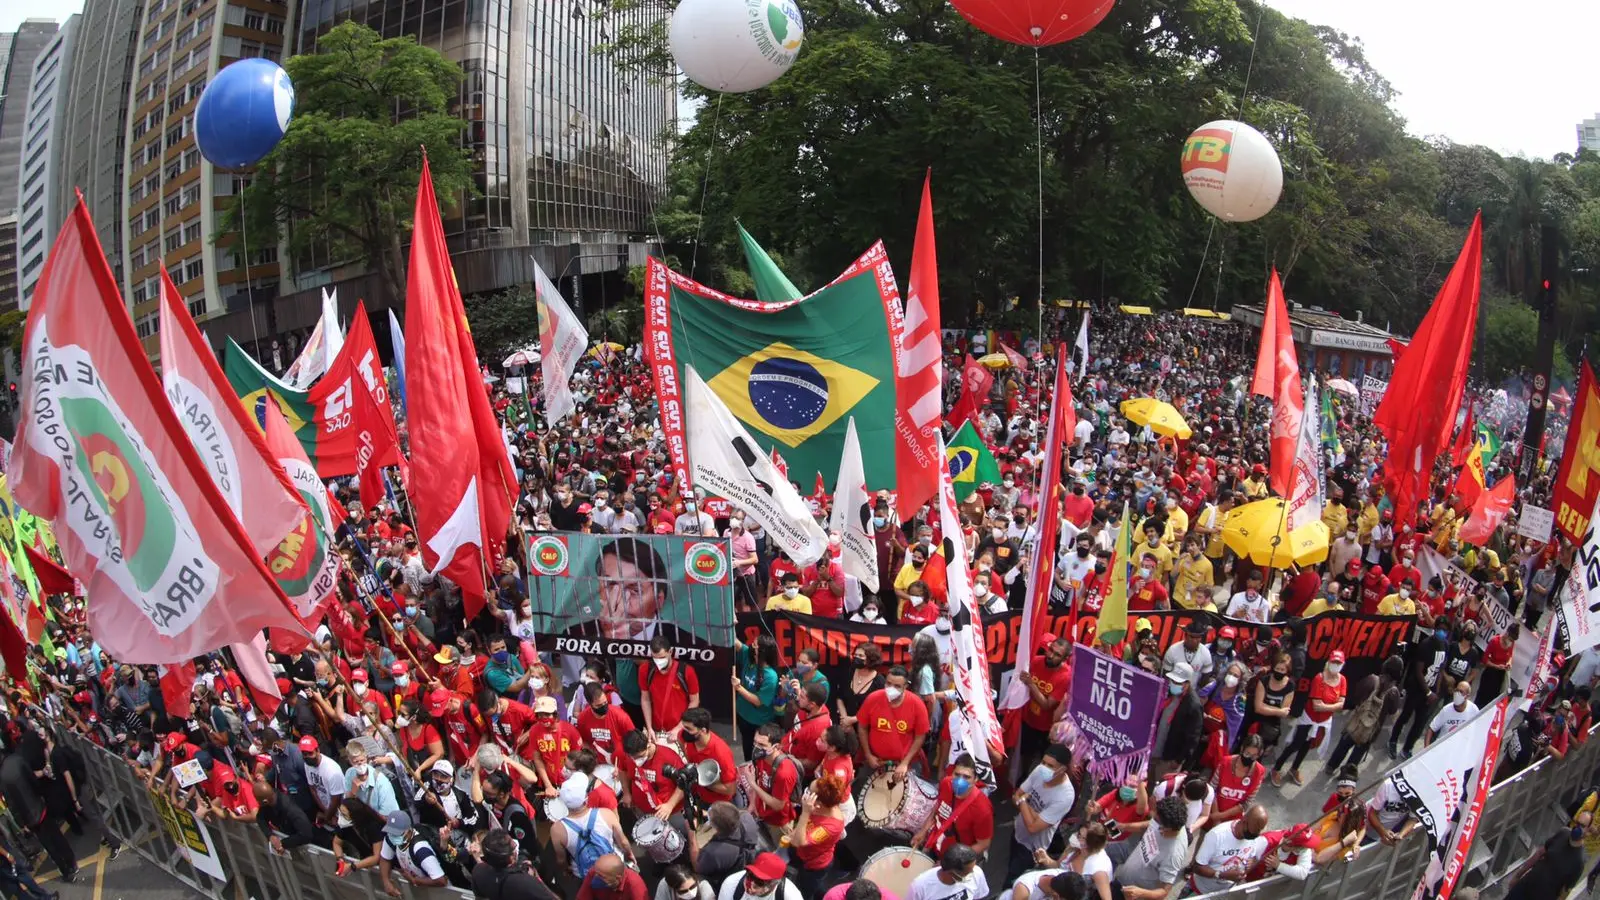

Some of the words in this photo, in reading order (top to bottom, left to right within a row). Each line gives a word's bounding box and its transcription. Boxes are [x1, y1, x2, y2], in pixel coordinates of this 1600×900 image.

[1182, 136, 1226, 163] TB
[881, 261, 898, 294] CUT
[656, 296, 668, 328] CUT
[658, 331, 672, 361] CUT
[663, 364, 678, 396] CUT
[783, 377, 826, 396] PROGRESSO
[1364, 377, 1385, 390] FORA
[1535, 376, 1545, 387] 50
[326, 413, 352, 433] SÃO
[668, 400, 681, 431] CUT
[671, 435, 685, 465] CUT
[696, 465, 728, 486] Sindicato
[728, 480, 742, 493] dos
[700, 474, 709, 483] de
[722, 485, 744, 503] Paulo,
[744, 497, 765, 516] Osasco
[769, 517, 785, 538] Região
[1557, 501, 1589, 539] REV
[696, 560, 715, 568] CMP
[1491, 604, 1511, 629] DOS
[556, 637, 602, 655] FORA
[607, 642, 715, 661] CORPTO
[774, 619, 913, 668] EMPREG
[1093, 657, 1134, 695] ELE
[1090, 682, 1132, 720] NÃO
[1220, 786, 1247, 800] CUT
[1416, 806, 1437, 838] UGT
[1461, 801, 1480, 841] UGT
[1445, 849, 1464, 888] UGT
